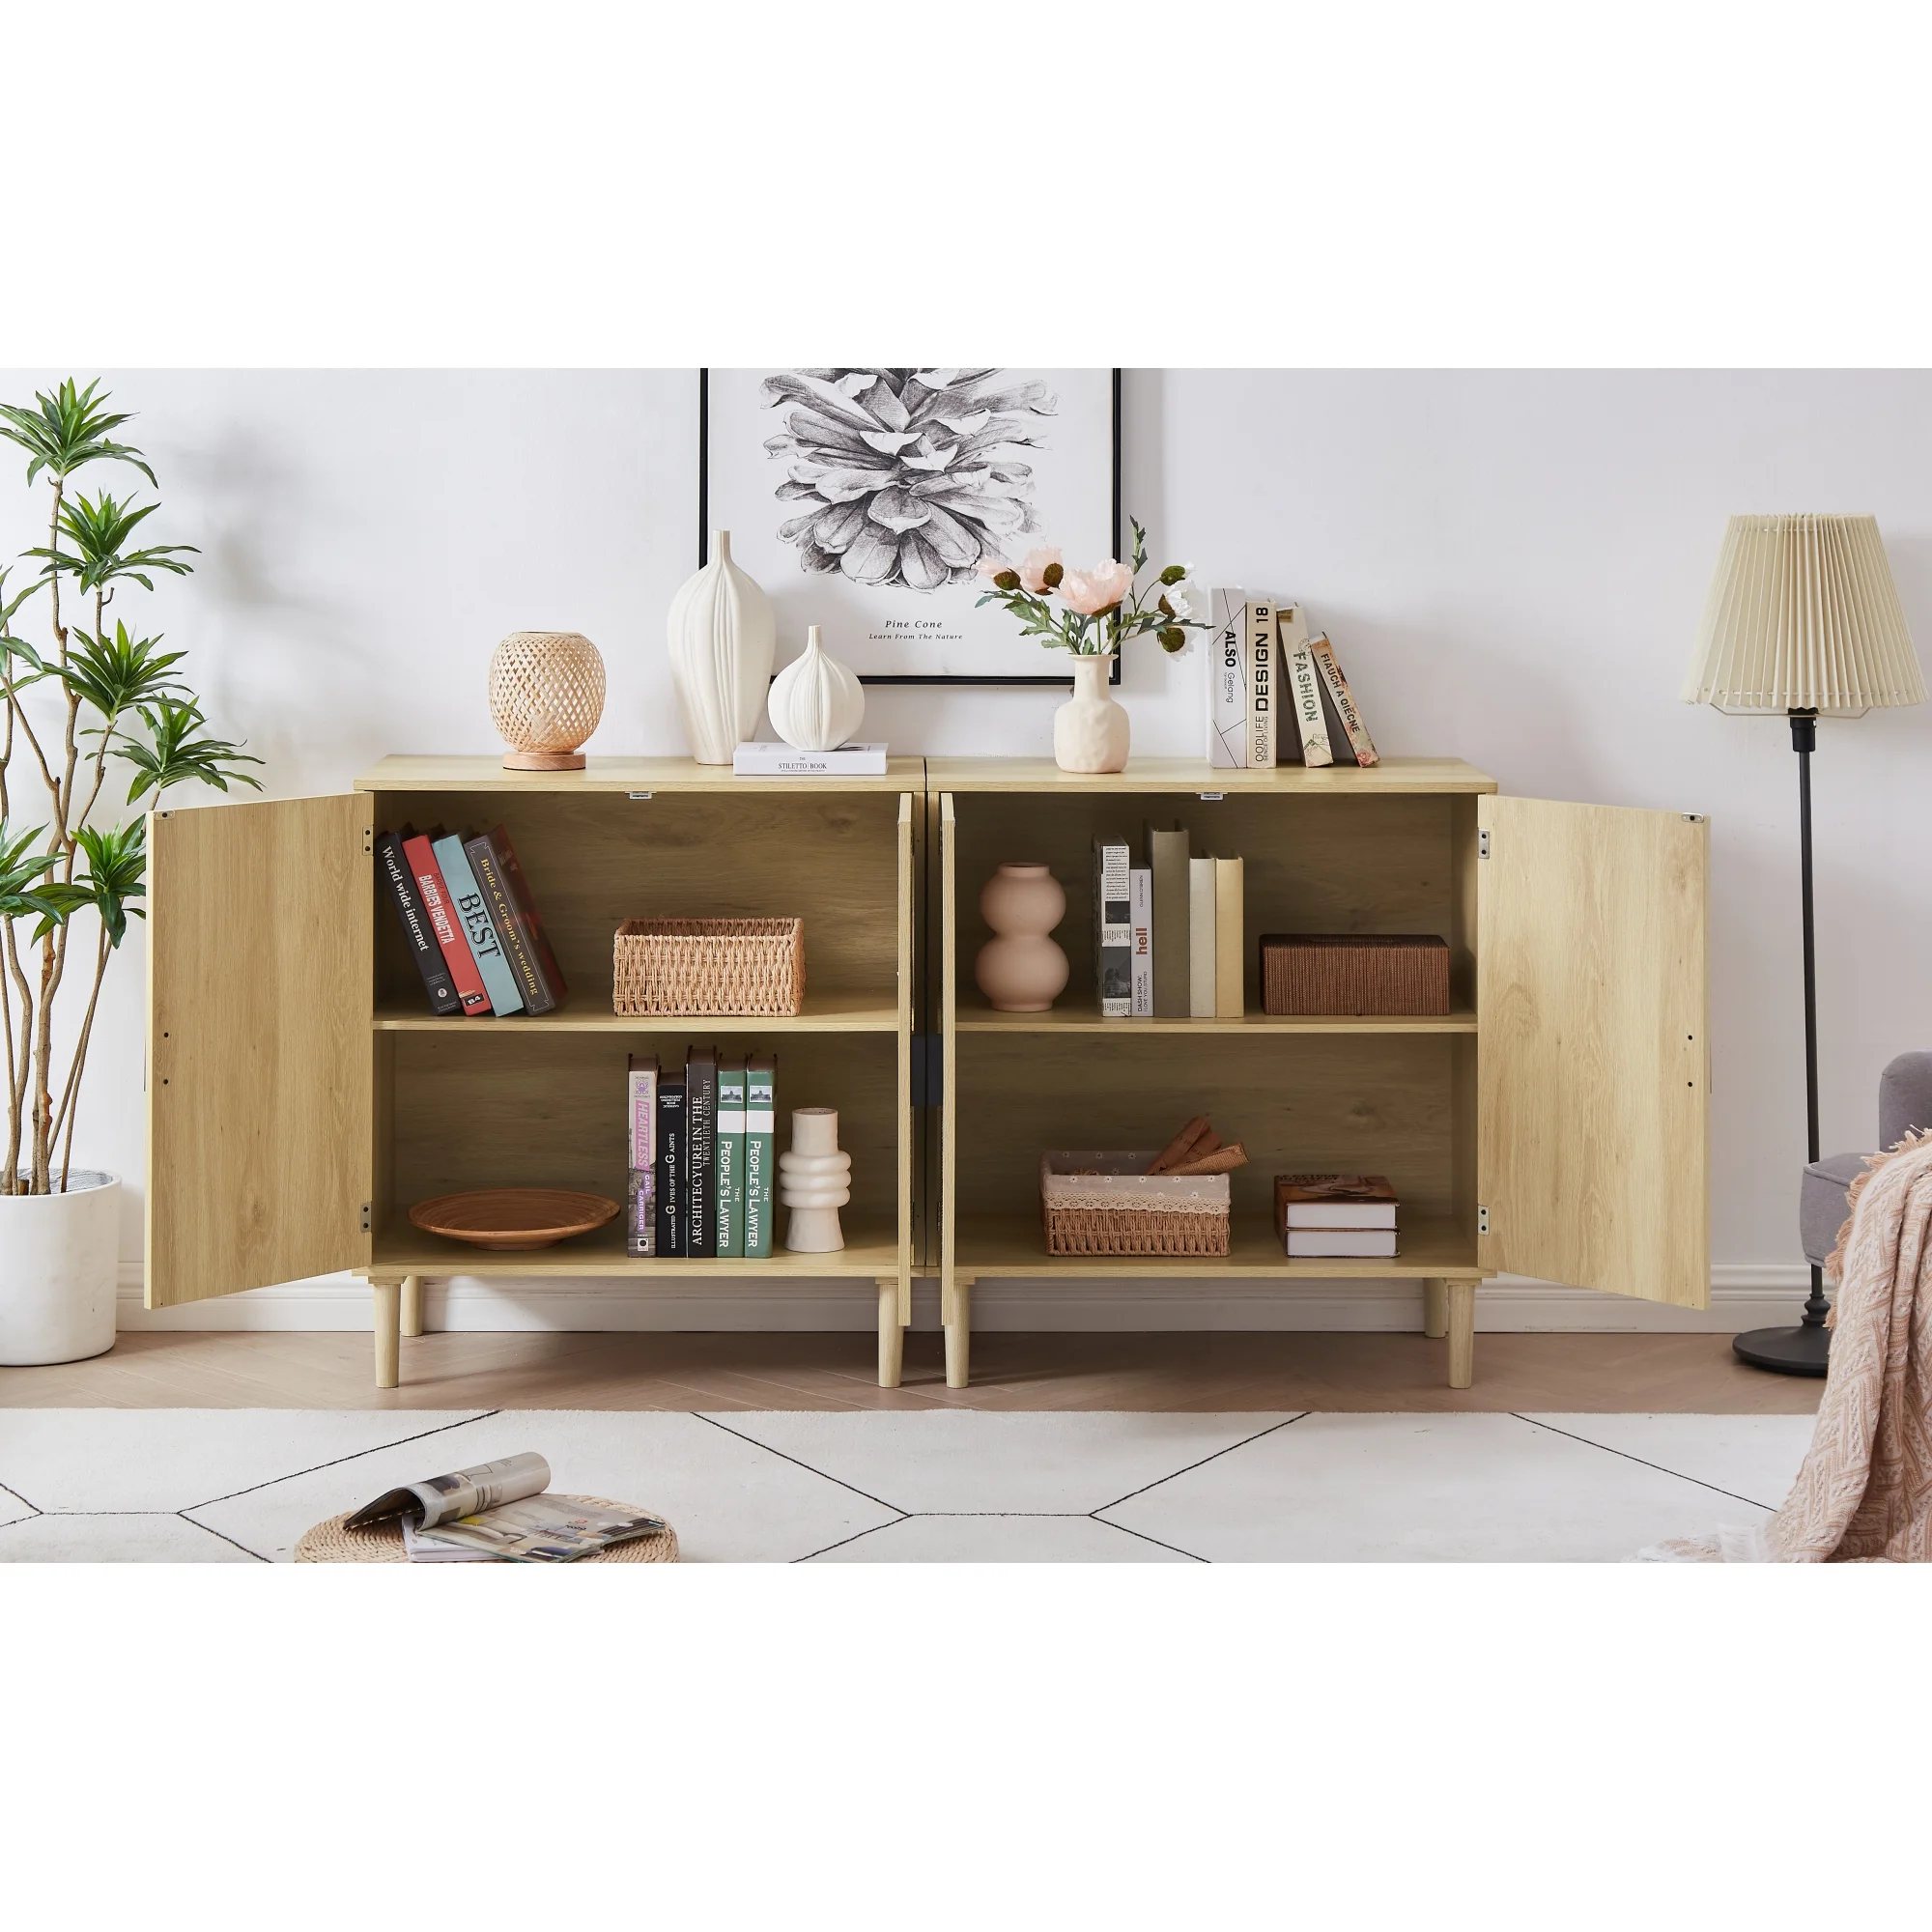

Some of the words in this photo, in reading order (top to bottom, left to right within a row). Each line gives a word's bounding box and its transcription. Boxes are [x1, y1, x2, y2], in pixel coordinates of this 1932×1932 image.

[885, 619, 909, 628] Pine
[1256, 607, 1268, 623] 18
[1224, 630, 1236, 668] ALSO
[1226, 672, 1236, 703] Gelang
[1256, 633, 1268, 711] DESIGN
[1293, 652, 1318, 723] FASHION
[1336, 690, 1344, 698] A
[383, 846, 403, 883] World
[395, 881, 411, 909] wide
[406, 908, 429, 952] internet
[431, 905, 455, 945] VENDETTA
[458, 893, 500, 958] BEST
[480, 858, 497, 889] Bride
[494, 891, 503, 900] &
[499, 903, 521, 951] Groom's
[518, 952, 538, 995] wedding
[1135, 927, 1148, 955] hell
[692, 1096, 702, 1123] THE
[702, 1079, 711, 1116] CENTURY
[638, 1103, 648, 1168] HEARTLESS
[692, 1126, 702, 1141] IN
[702, 1120, 711, 1166] TWENTIETH
[669, 1178, 675, 1187] OF
[720, 1140, 732, 1196] PEOPLE'S
[749, 1140, 761, 1196] PEOPLE'S
[719, 1197, 731, 1248] LAWYER
[748, 1197, 760, 1248] LAWYER
